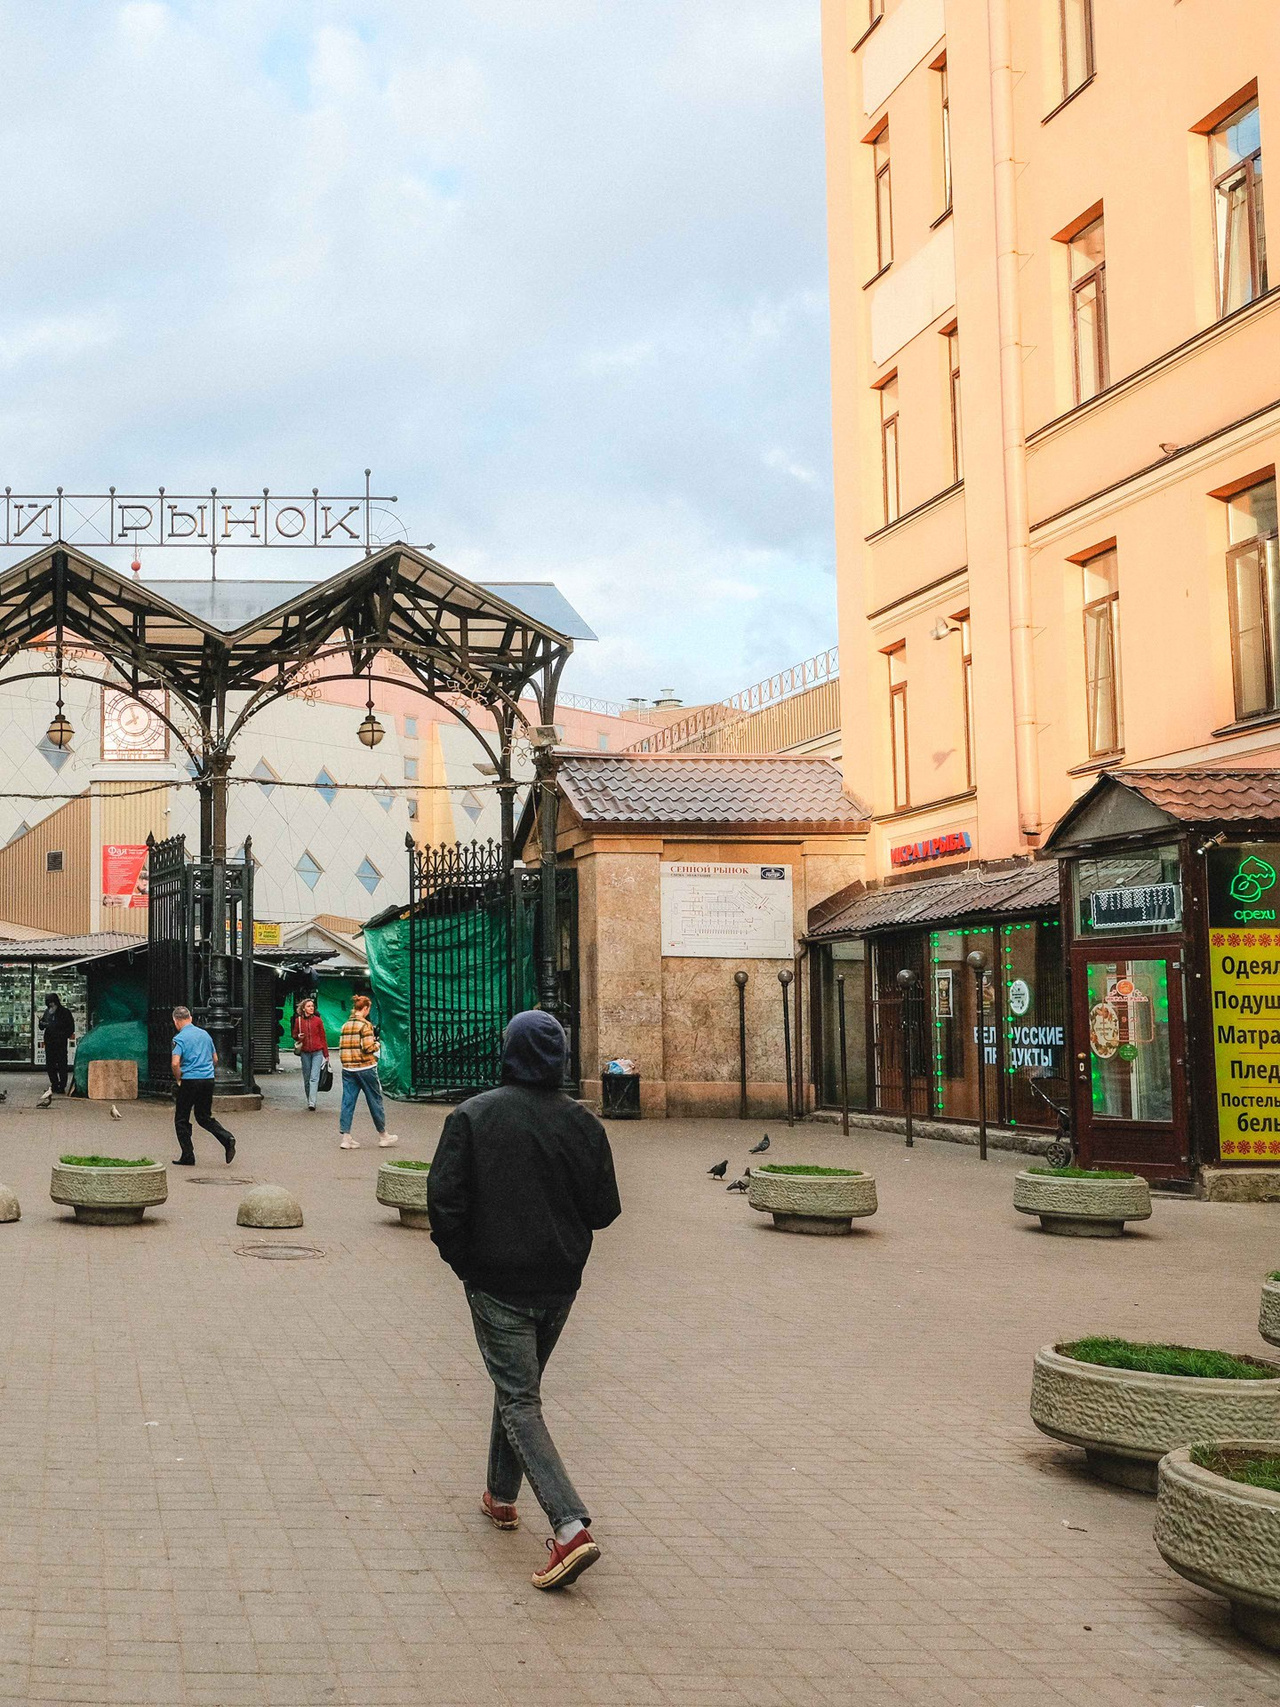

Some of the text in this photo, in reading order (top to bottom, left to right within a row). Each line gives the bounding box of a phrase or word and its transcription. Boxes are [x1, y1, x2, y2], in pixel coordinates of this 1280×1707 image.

[118, 504, 361, 539] РЫНОК
[891, 832, 968, 863] ИКРА И РЫБА
[670, 865, 711, 874] СЕННОЙ
[1234, 909, 1276, 923] орехи
[973, 1026, 1064, 1045] БЕЛУССКИЕ
[1218, 1026, 1280, 1049] Матра
[984, 1047, 1053, 1068] ПРДУКТЫ
